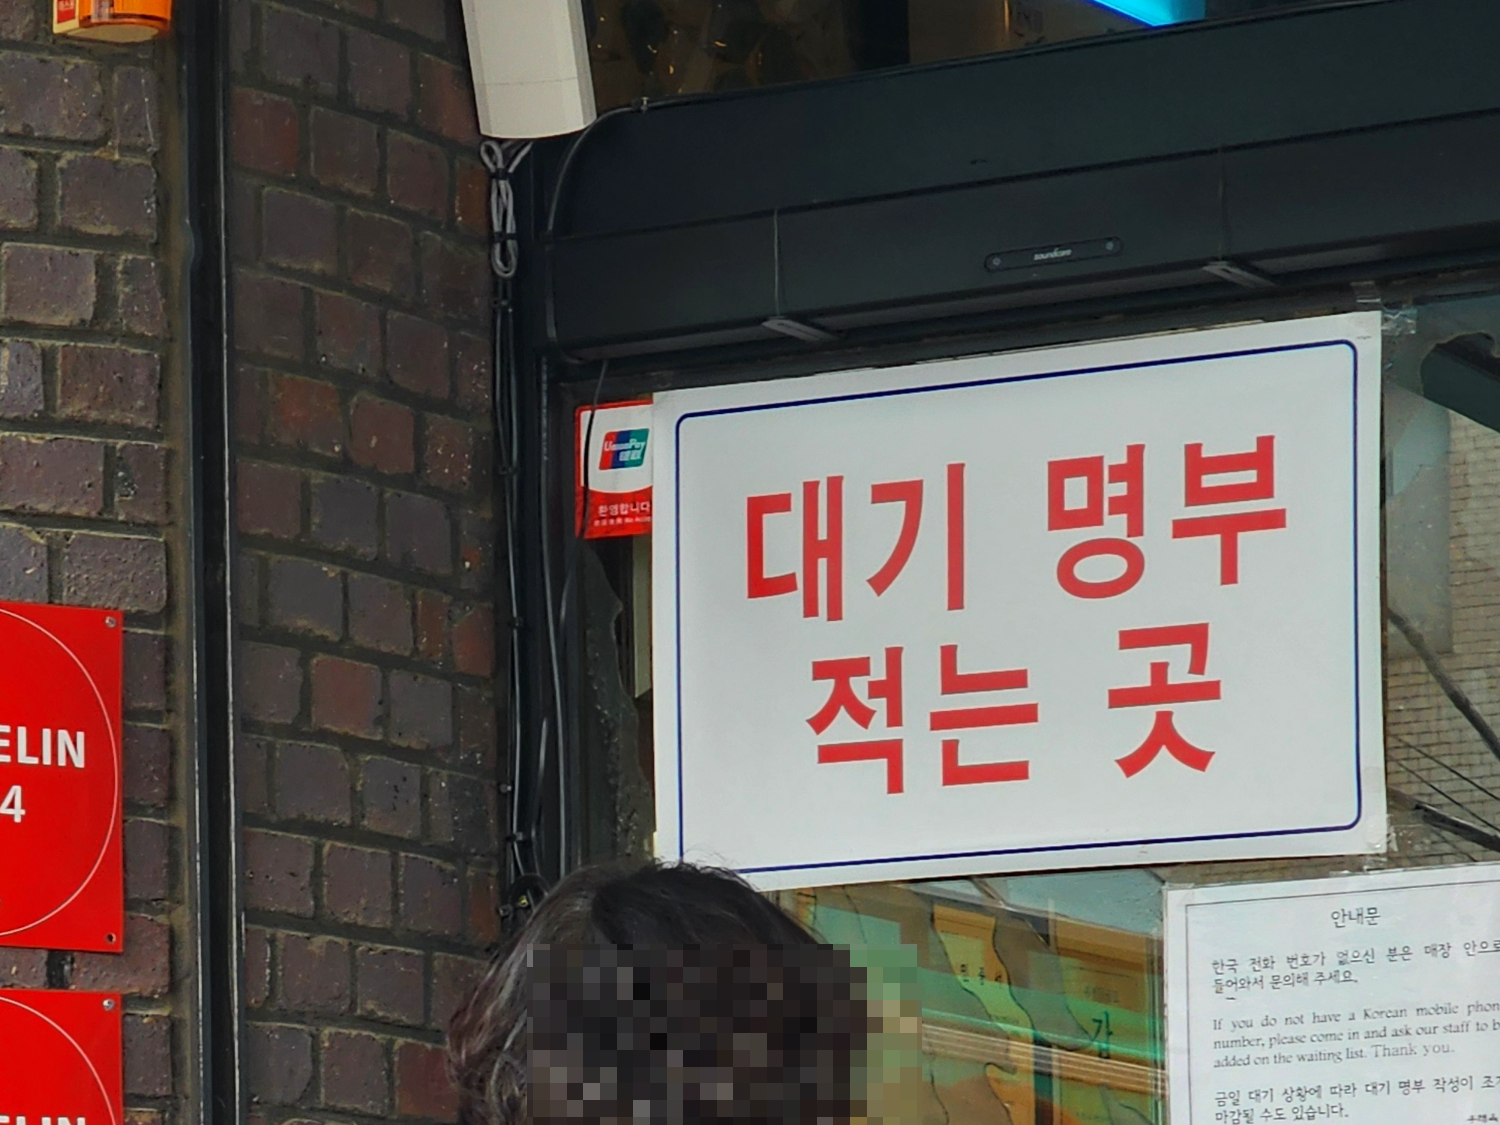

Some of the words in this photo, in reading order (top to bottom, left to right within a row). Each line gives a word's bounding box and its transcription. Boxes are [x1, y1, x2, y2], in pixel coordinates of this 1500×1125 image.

[746, 462, 967, 622] 대기
[1047, 434, 1289, 599] 명부
[807, 643, 1040, 795] 적는
[1108, 622, 1222, 778] 곳
[1331, 906, 1381, 928] 안내문
[1212, 958, 1239, 975] 한국
[1250, 955, 1276, 972] 전화
[1286, 951, 1326, 969] 번호가
[1337, 947, 1375, 966] 없으신
[1386, 946, 1413, 962] 분은
[1424, 942, 1452, 959] 매장
[1269, 971, 1309, 989] 문의해
[1314, 969, 1358, 985] 주세요.
[1213, 1018, 1224, 1030] If
[1231, 1019, 1253, 1032] you
[1261, 1015, 1277, 1027] do
[1284, 1014, 1304, 1026] not
[1312, 1012, 1341, 1024] have
[1348, 1012, 1356, 1021] a
[1363, 1007, 1407, 1020] Korean
[1416, 1002, 1459, 1016] mobile
[1213, 1035, 1265, 1049] number,
[1269, 1033, 1307, 1049] please
[1310, 1030, 1343, 1043] come
[1347, 1029, 1360, 1040] in
[1364, 1026, 1387, 1040] and
[1391, 1024, 1413, 1037] ask
[1415, 1024, 1439, 1036] our
[1442, 1020, 1471, 1034] staff
[1476, 1021, 1489, 1032] to
[1213, 1055, 1250, 1069] added
[1253, 1055, 1270, 1066] on
[1273, 1052, 1293, 1064] the
[1296, 1049, 1343, 1064] waiting
[1345, 1047, 1367, 1060] list.
[1371, 1042, 1417, 1058] Thank
[1423, 1043, 1455, 1057] you.
[1214, 1090, 1241, 1107] 금일
[1248, 1088, 1274, 1103] 대기
[1282, 1084, 1322, 1104] 상황에
[1329, 1082, 1357, 1098] 따라
[1364, 1080, 1390, 1096] 대기
[1398, 1079, 1426, 1096] 명부
[1433, 1075, 1473, 1093] 작성이
[1481, 1075, 1500, 1089] 조
[1215, 1108, 1254, 1125] 마감될
[1259, 1107, 1287, 1122] 수도
[1291, 1102, 1349, 1122] 있습니다.
